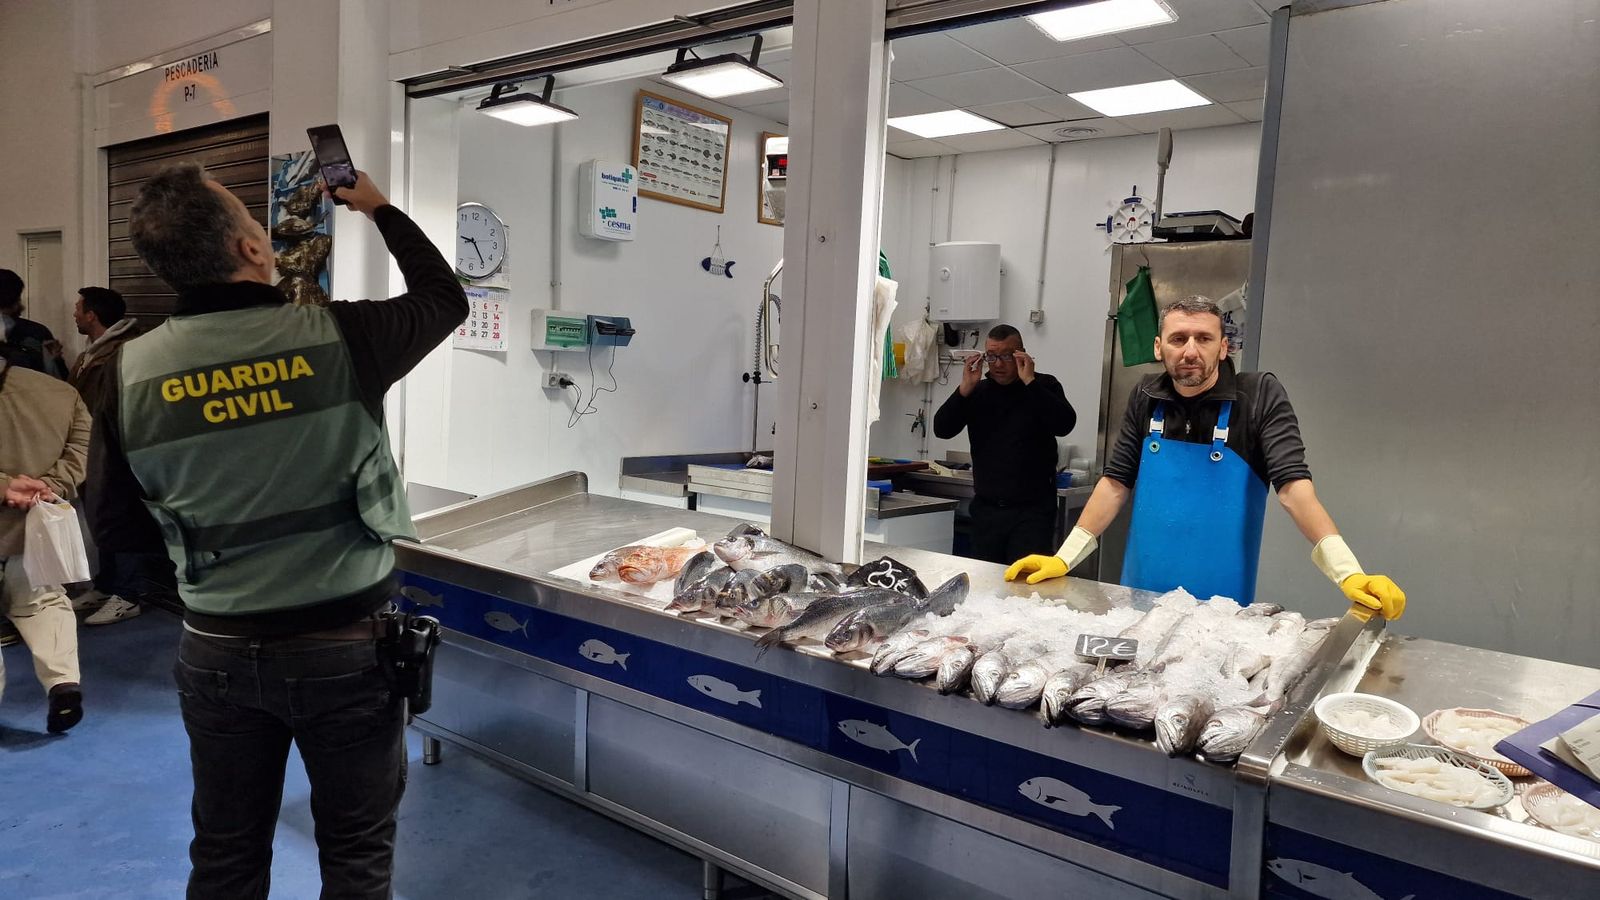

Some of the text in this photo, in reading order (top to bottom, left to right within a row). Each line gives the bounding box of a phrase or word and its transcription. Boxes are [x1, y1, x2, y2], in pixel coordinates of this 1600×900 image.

[165, 51, 219, 82] PESCADERIA
[184, 84, 196, 102] P-7
[461, 213, 467, 222] 11
[472, 212, 480, 221] 12
[607, 219, 631, 231] cesma
[490, 229, 496, 237] 2
[492, 241, 498, 250] 3
[468, 262, 474, 271] 6
[472, 301, 499, 312] 5 6 7
[482, 311, 488, 320] 13
[493, 313, 499, 321] 14
[459, 328, 466, 336] 25
[481, 330, 488, 338] 27
[492, 331, 500, 339] 28
[161, 355, 315, 403] GUARDIA
[203, 388, 294, 424] CIVIL
